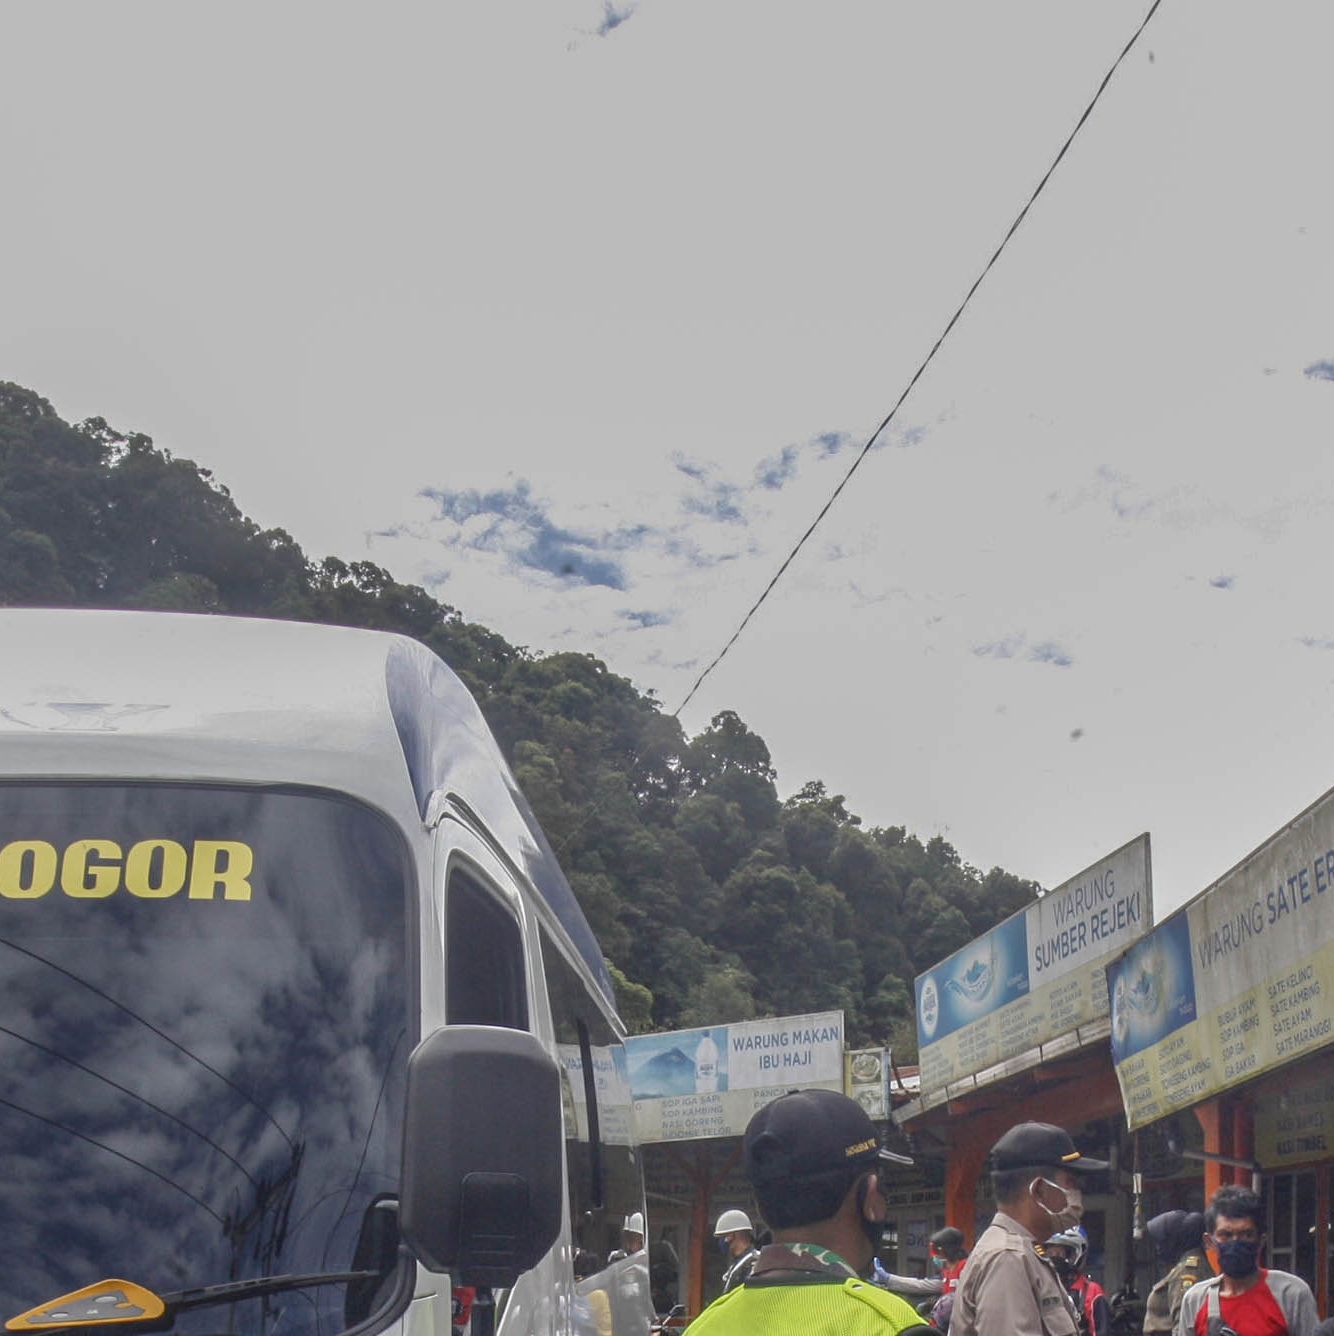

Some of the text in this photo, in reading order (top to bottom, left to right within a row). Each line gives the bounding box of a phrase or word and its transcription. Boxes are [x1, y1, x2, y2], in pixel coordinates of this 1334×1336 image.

[1053, 870, 1115, 928] WARUNG
[1034, 891, 1141, 972] SUMBER REJEKI
[1198, 902, 1264, 969] WARUNG
[1266, 868, 1311, 925] SATE
[1268, 981, 1286, 1000] SATE
[1270, 980, 1320, 1017] SATE KAMBING
[1273, 1007, 1313, 1037] SATE AYAM
[732, 1026, 839, 1051] WARUNG MAKAN
[1275, 1038, 1293, 1056] SATE
[759, 1050, 812, 1070] IBU HAJI
